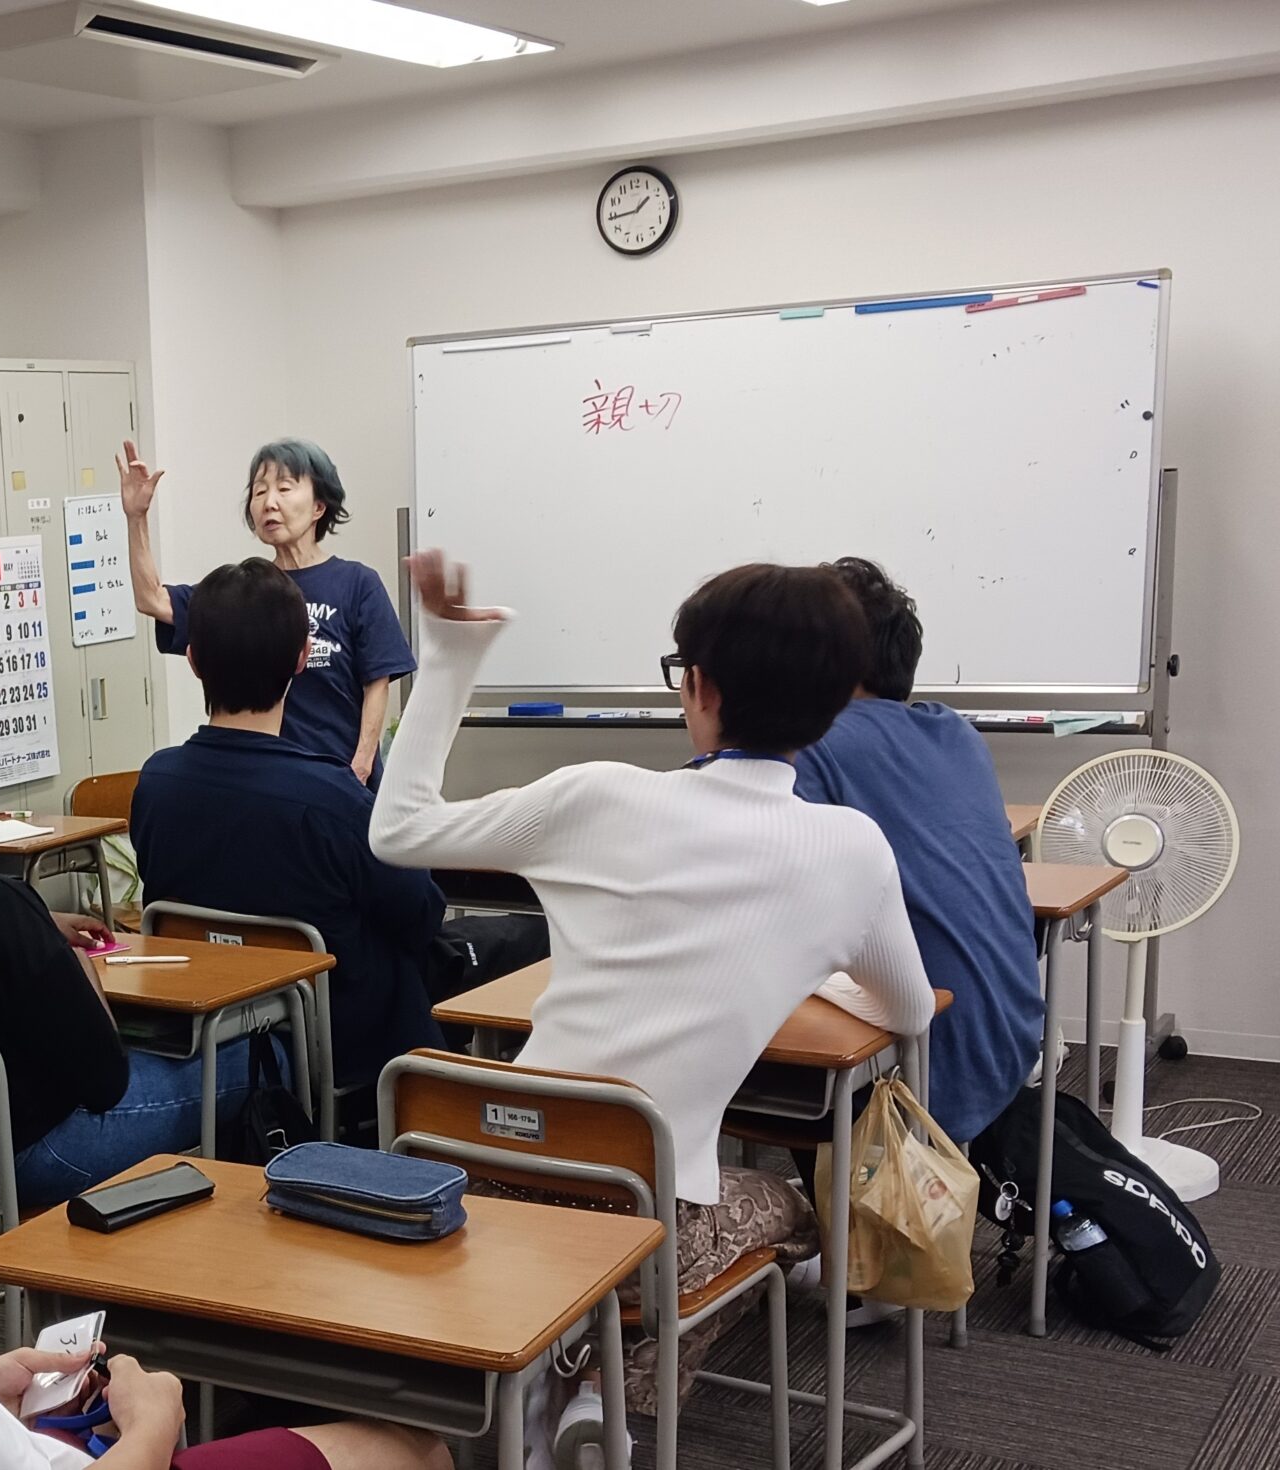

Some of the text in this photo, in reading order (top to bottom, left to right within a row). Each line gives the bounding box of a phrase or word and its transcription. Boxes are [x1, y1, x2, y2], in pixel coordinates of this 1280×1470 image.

[583, 379, 681, 434] 親切
[4, 563, 13, 571] MAY
[4, 593, 10, 609] 2
[18, 591, 24, 607] 3
[32, 590, 38, 606] 4
[6, 624, 12, 641] 9
[18, 622, 29, 639] 10
[32, 620, 42, 637] 11
[6, 655, 18, 672] 16
[20, 653, 31, 670] 17
[34, 651, 46, 668] 18
[9, 686, 21, 703] 23
[23, 684, 34, 701] 24
[36, 681, 48, 699] 25
[0, 719, 10, 736] 29
[12, 716, 24, 734] 30
[26, 714, 37, 731] 31
[491, 1108, 498, 1120] 1
[1102, 1169, 1207, 1269] adidas
